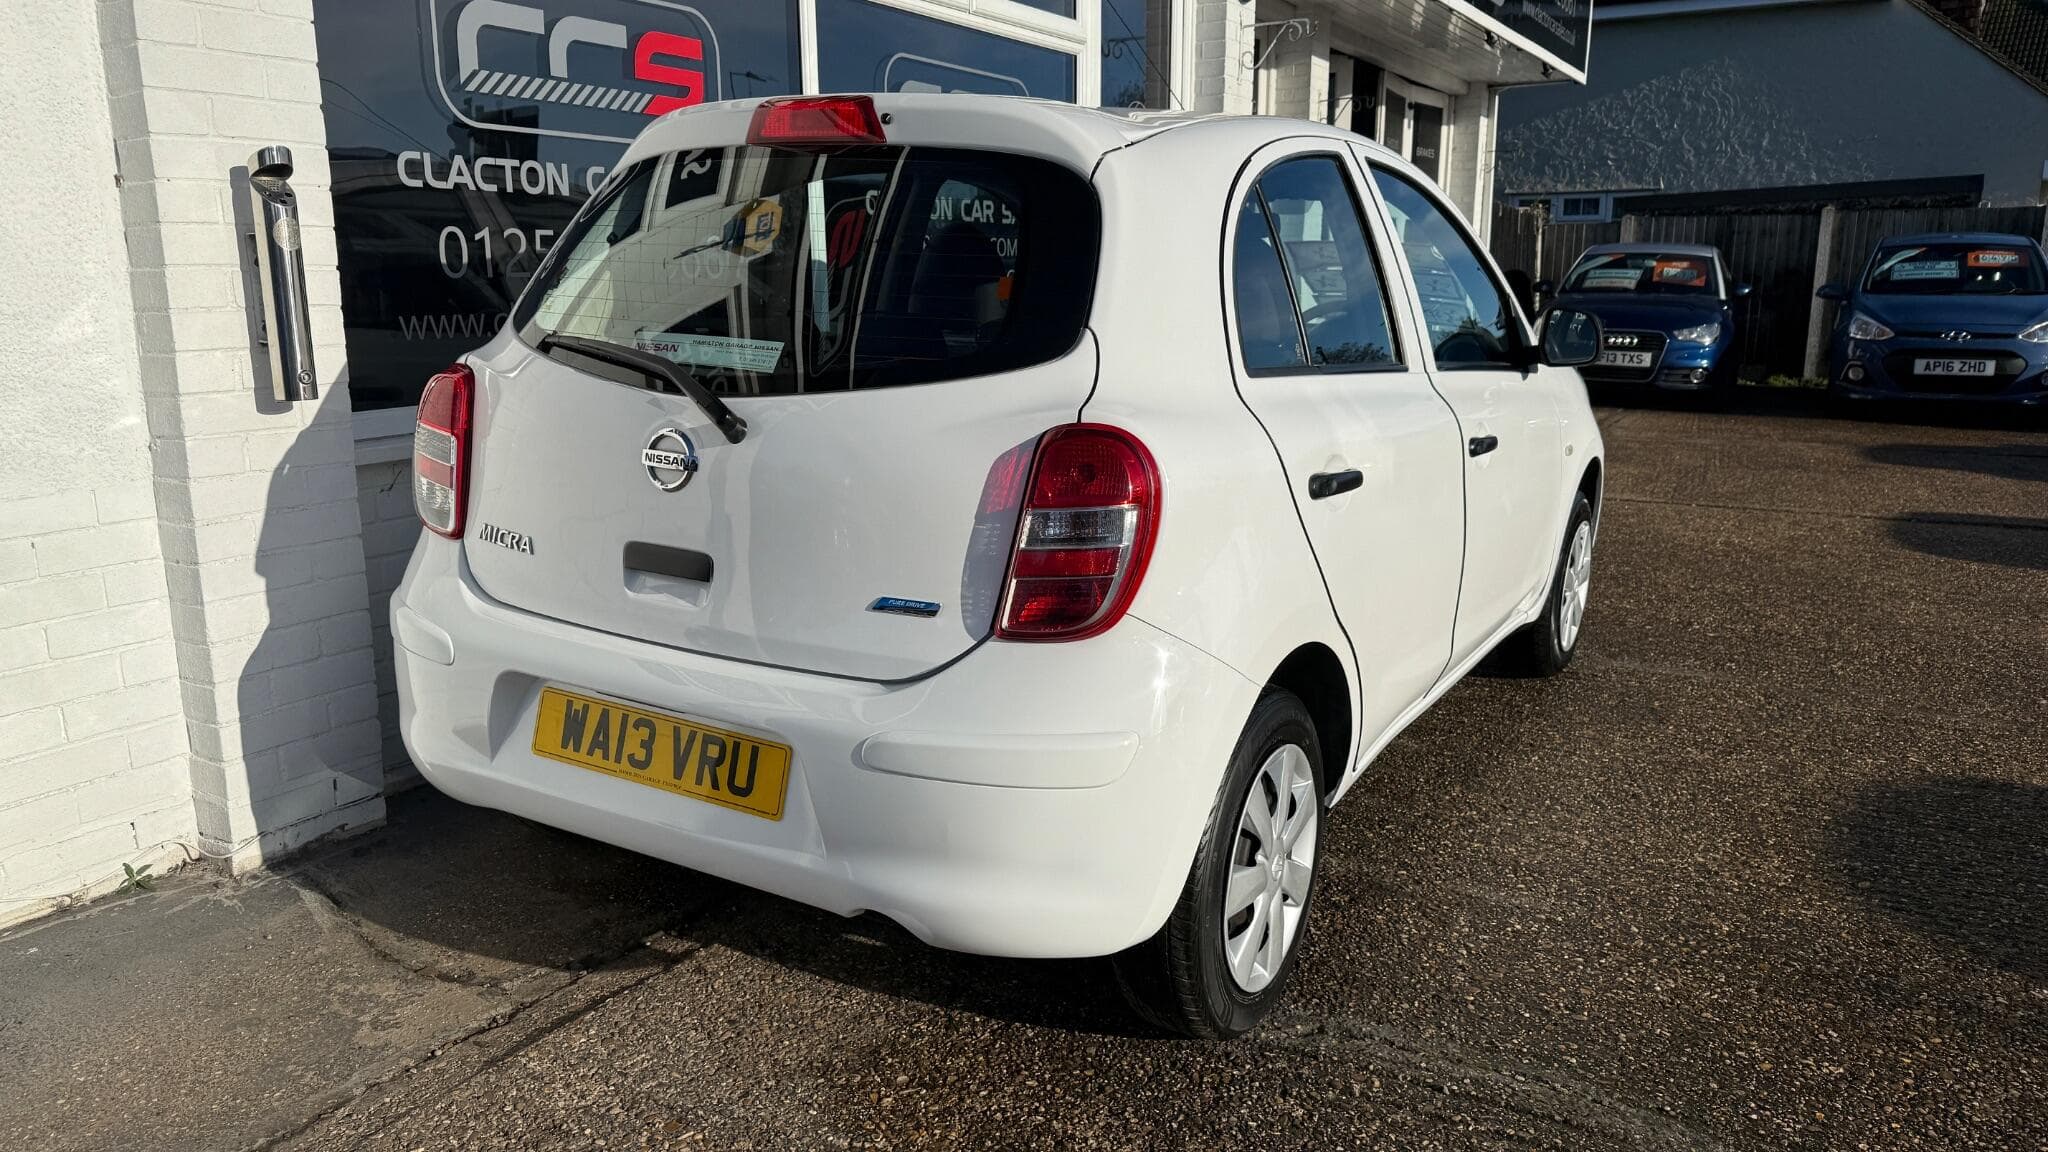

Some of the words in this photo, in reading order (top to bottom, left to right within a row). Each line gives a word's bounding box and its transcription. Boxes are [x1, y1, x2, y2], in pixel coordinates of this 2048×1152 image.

[396, 150, 570, 197] CLACTON
[960, 199, 994, 223] CAR
[635, 342, 680, 353] NISSAN
[1620, 353, 1644, 365] TXS
[1923, 360, 1956, 373] AP16
[1958, 361, 1987, 373] ZHD
[644, 452, 691, 468] NISSAN
[479, 522, 535, 556] MICRA
[560, 698, 657, 771] WA13
[672, 724, 761, 799] VRU
